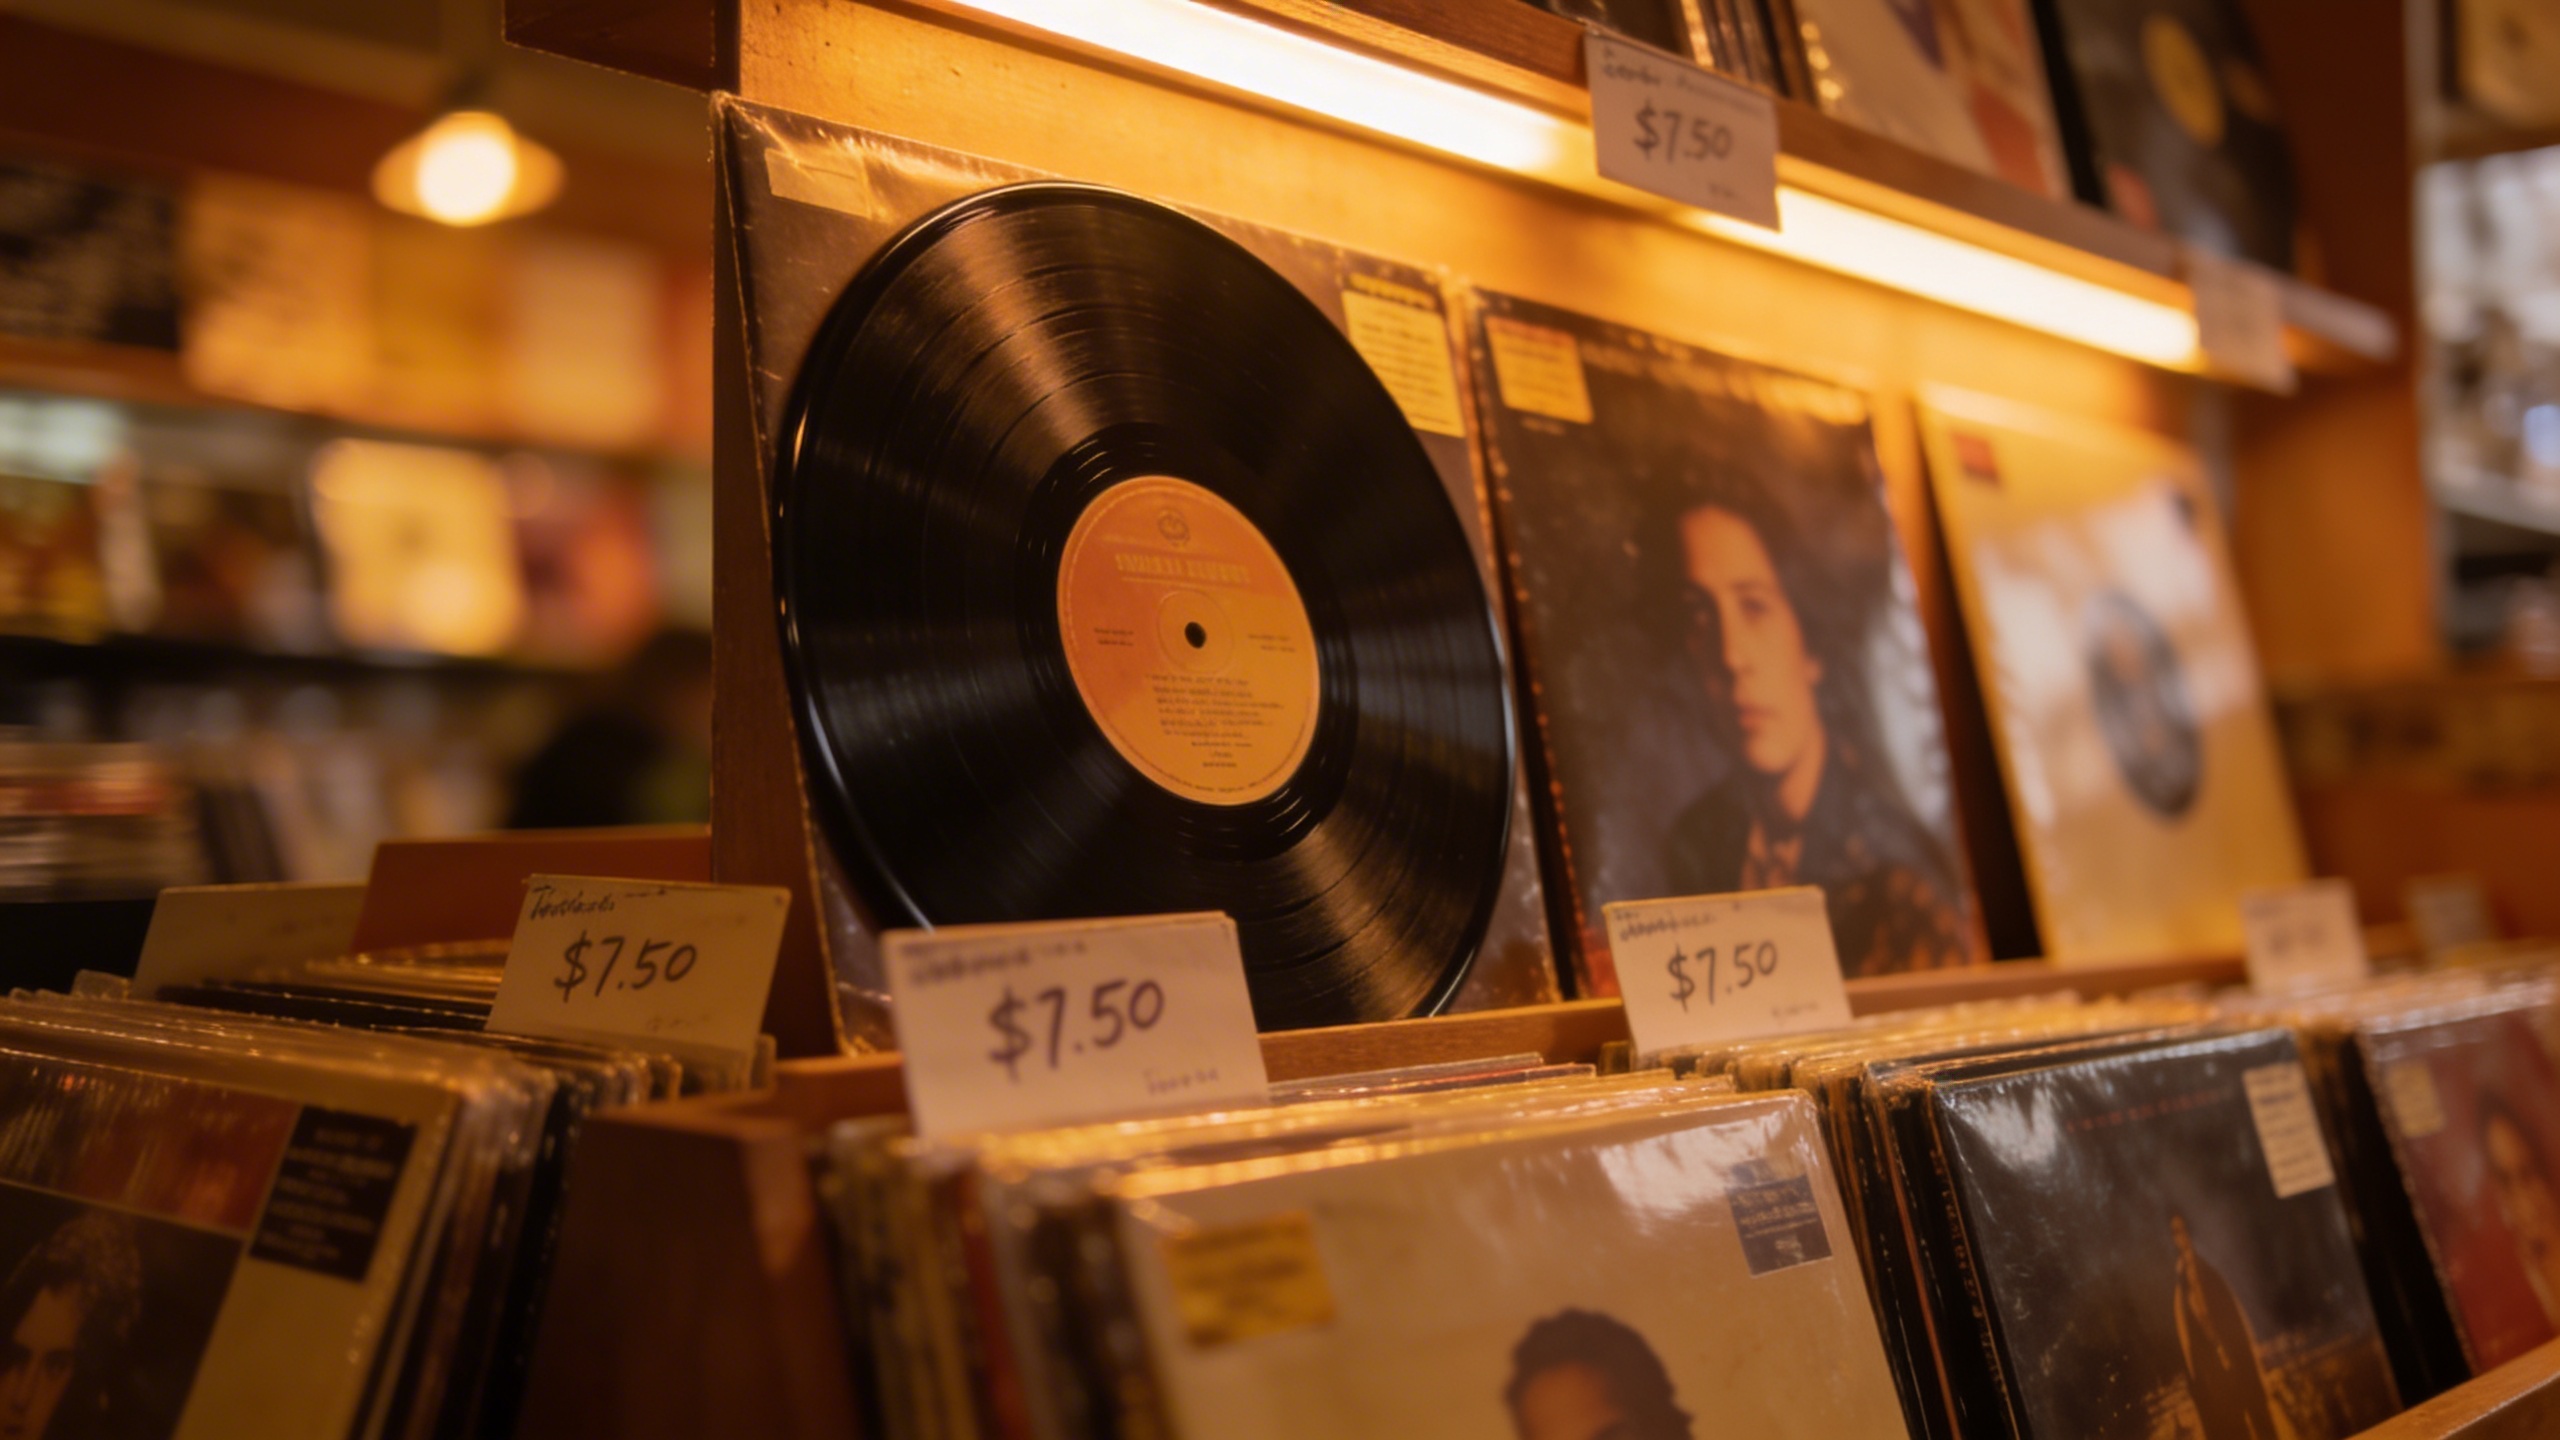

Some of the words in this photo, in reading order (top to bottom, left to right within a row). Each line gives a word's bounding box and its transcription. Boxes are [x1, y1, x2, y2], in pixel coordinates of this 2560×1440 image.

[1633, 98, 1732, 164] $7.50
[554, 930, 697, 1003] $7.50
[1667, 940, 1778, 1013] $7.50
[988, 978, 1165, 1084] $7.50
